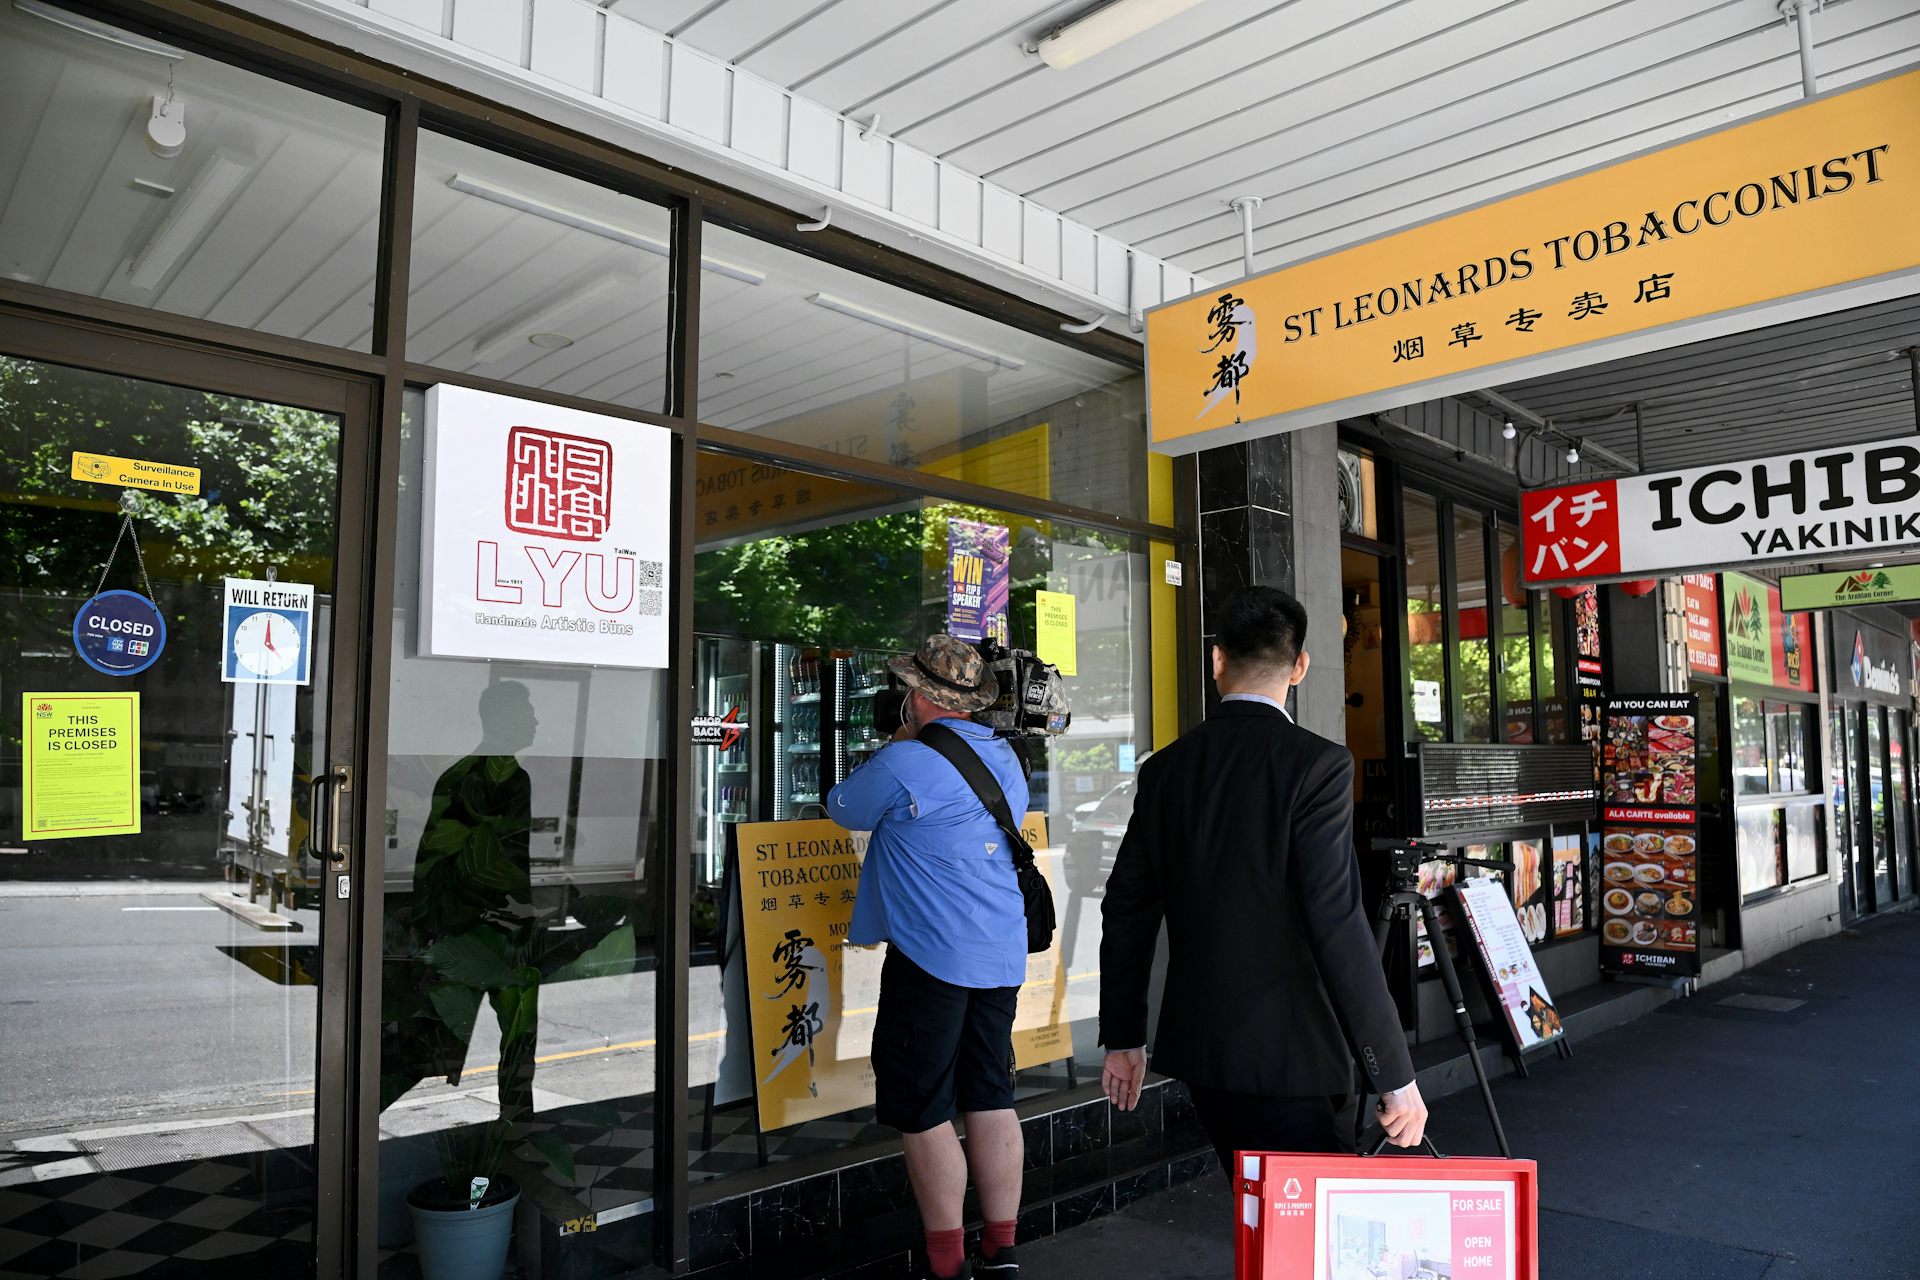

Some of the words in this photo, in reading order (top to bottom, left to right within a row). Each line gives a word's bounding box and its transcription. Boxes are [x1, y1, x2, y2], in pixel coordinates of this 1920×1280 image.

[1283, 306, 1324, 344] ST
[1334, 247, 1534, 331] LEONARDS
[1543, 143, 1890, 270] TOBACCONIST
[1392, 271, 1676, 364] 烟草专卖店
[133, 462, 195, 478] Surveillance
[119, 474, 160, 487] Camera
[162, 479, 172, 489] In
[175, 480, 194, 491] Use
[613, 547, 637, 556] TaiWan
[953, 553, 983, 586] WIN
[477, 541, 634, 613] LYU
[232, 588, 259, 605] WILL
[263, 591, 308, 609] RETURN
[1848, 592, 1872, 600] Arabian
[1873, 590, 1894, 598] Corner
[1045, 612, 1067, 621] PREMISES
[88, 615, 154, 637] CLOSED
[475, 613, 537, 629] Handmade
[541, 615, 595, 633] Artistic
[599, 619, 634, 635] Büns
[1050, 620, 1068, 628] CLOSED
[1623, 701, 1645, 709] YOU
[1646, 701, 1668, 709] CAN
[1669, 700, 1690, 709] EAT
[67, 715, 98, 725] THIS
[49, 728, 116, 738] PREMISES
[694, 727, 721, 736] BACK
[48, 742, 60, 751] IS
[64, 740, 117, 750] CLOSED
[1609, 810, 1625, 818] ALA
[1626, 810, 1653, 819] CARTE
[1654, 811, 1690, 820] available
[757, 843, 778, 861] ST
[1635, 953, 1676, 965] ICHIBAN
[1453, 1199, 1474, 1211] FOR
[1476, 1199, 1502, 1211] SALE
[1464, 1236, 1492, 1248] OPEN
[1464, 1256, 1493, 1268] HOME
